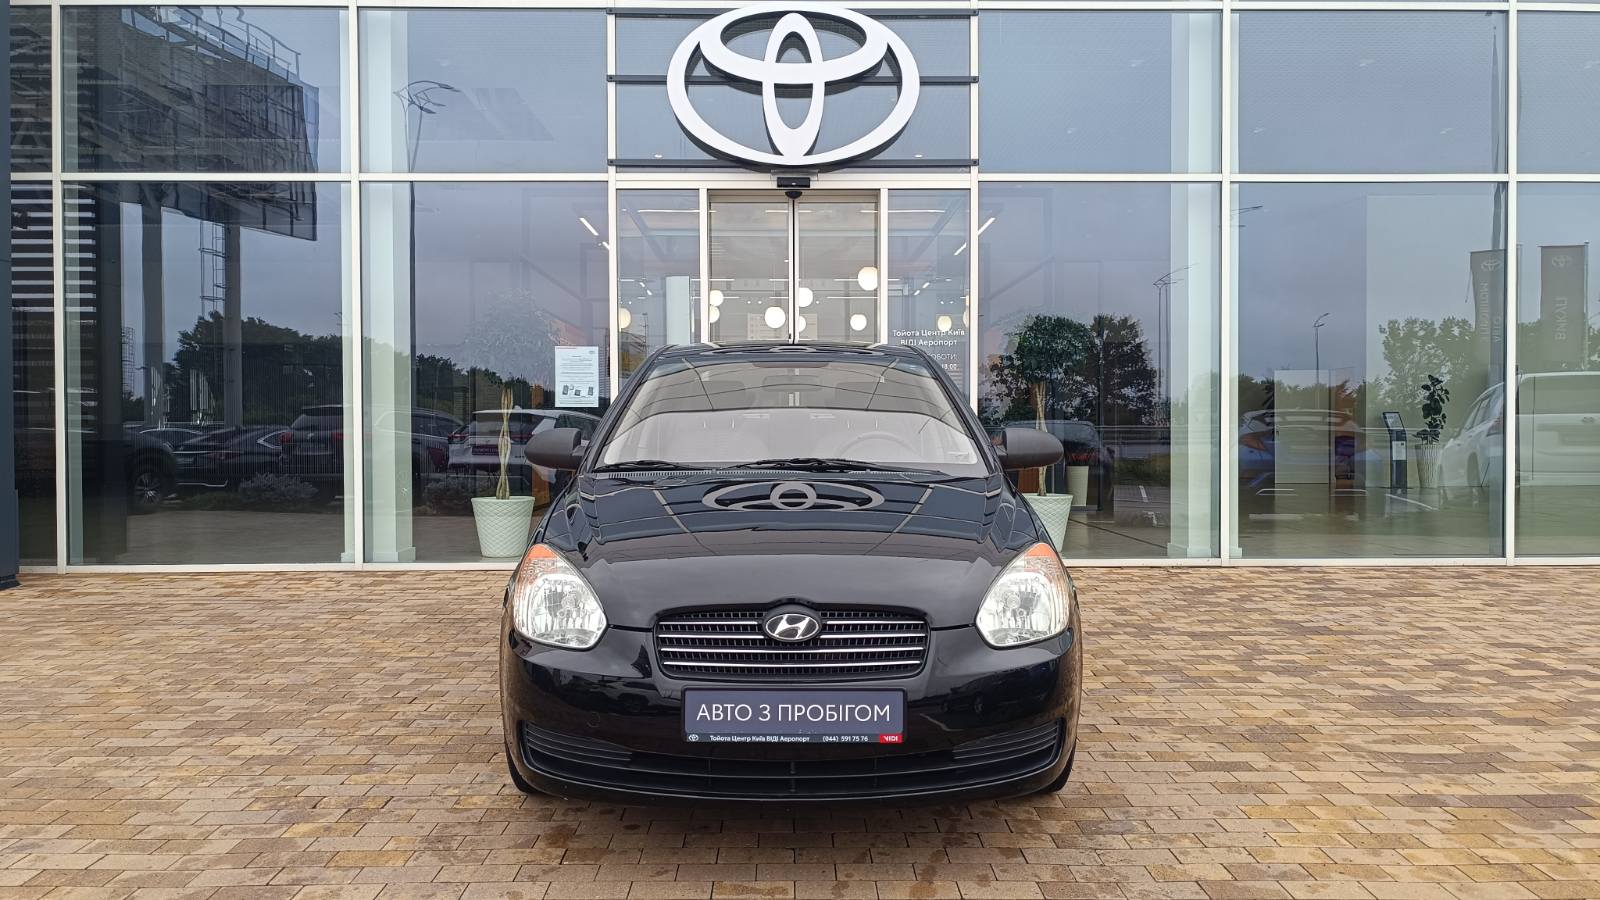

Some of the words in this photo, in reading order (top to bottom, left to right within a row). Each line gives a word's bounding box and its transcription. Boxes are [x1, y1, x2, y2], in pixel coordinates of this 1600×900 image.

[918, 339, 957, 347] Аеропорт
[697, 704, 753, 721] АВТО
[758, 704, 771, 721] З
[778, 704, 891, 721] ПРОБІГОМ
